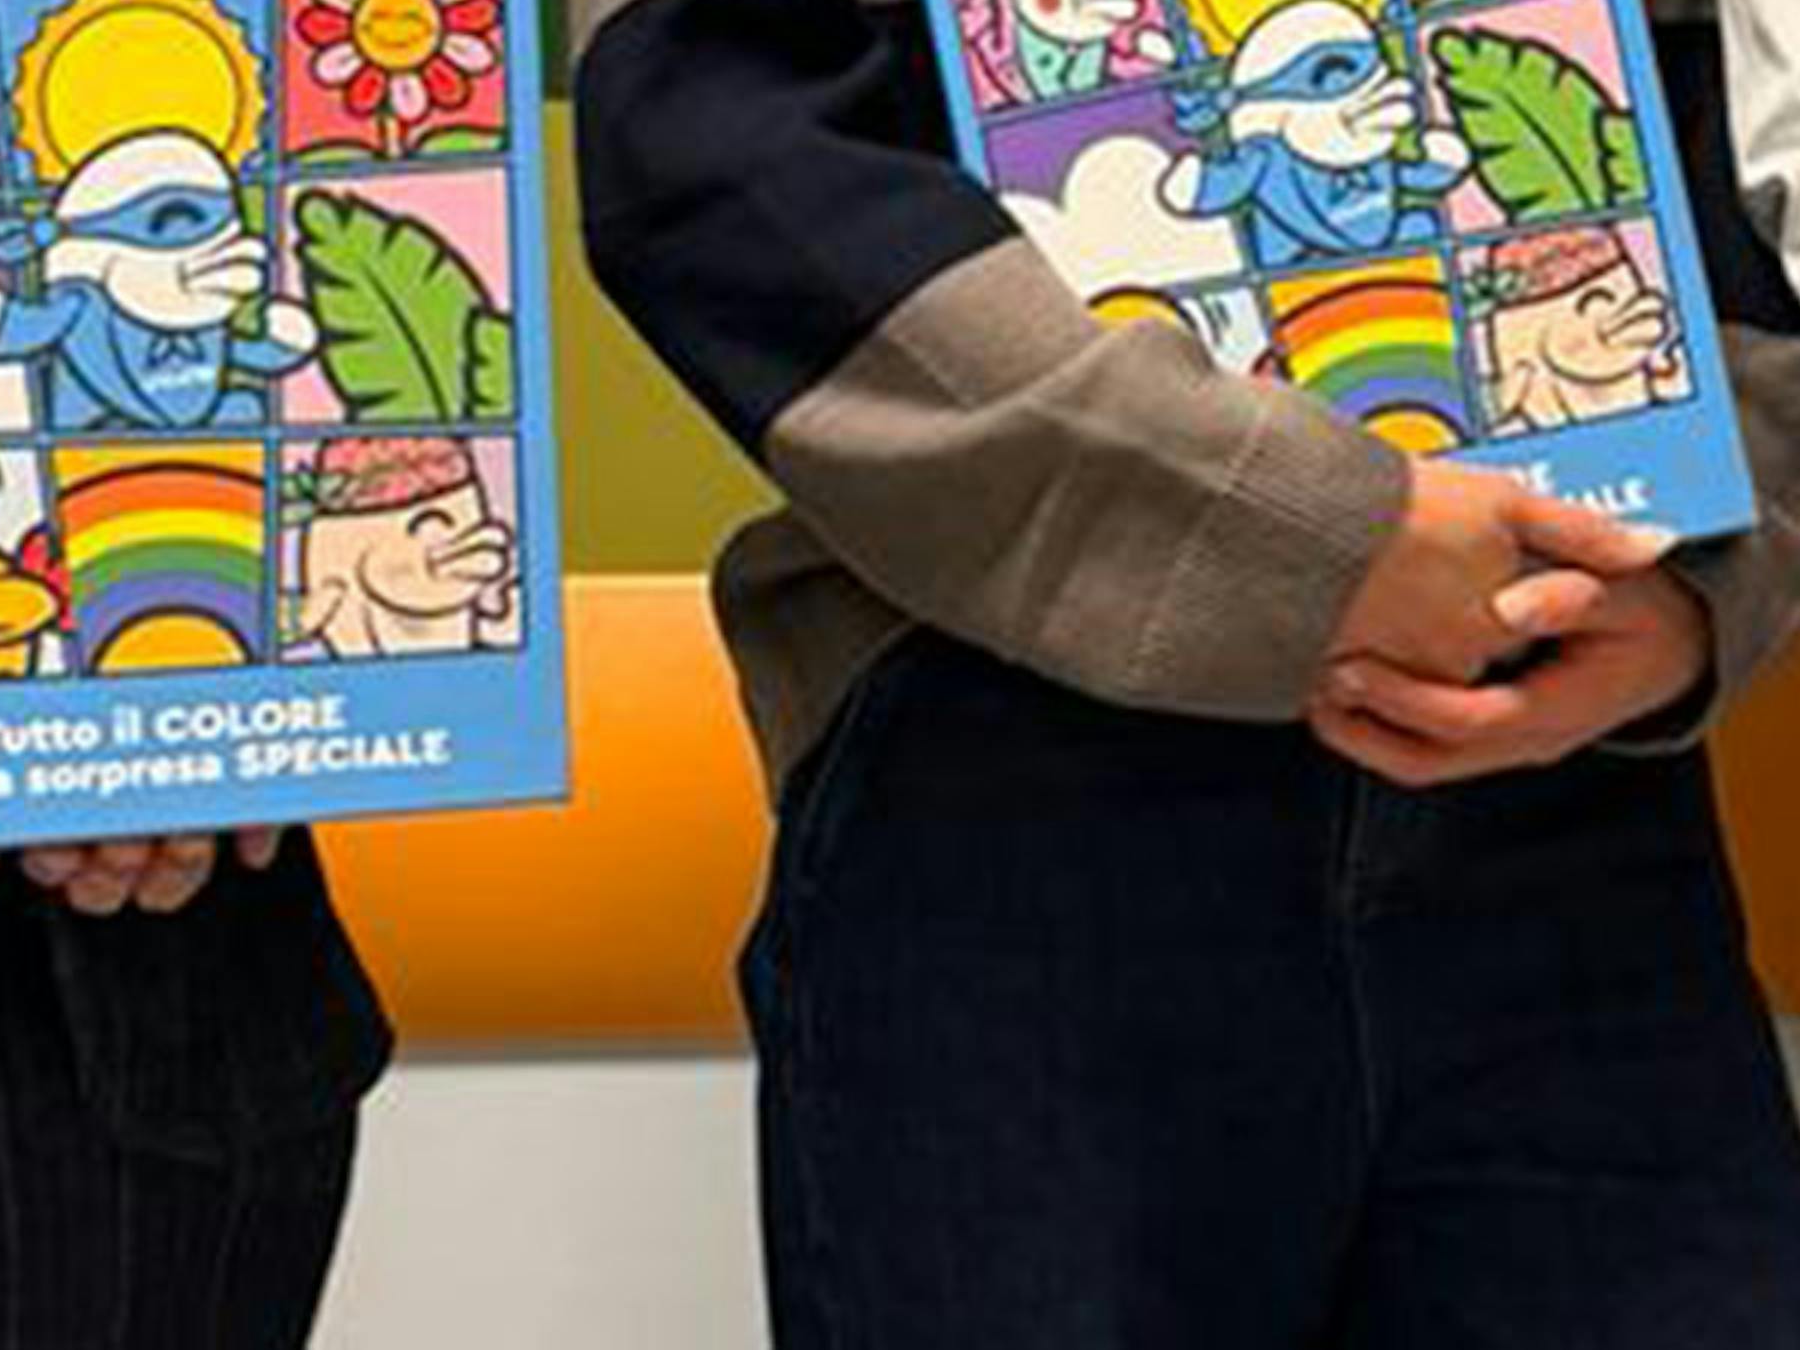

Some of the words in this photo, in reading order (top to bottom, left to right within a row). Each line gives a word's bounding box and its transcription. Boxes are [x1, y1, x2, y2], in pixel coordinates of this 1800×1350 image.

[113, 705, 142, 745] il
[154, 696, 348, 742] COLORE
[27, 752, 223, 796] sorpresa
[235, 729, 451, 779] SPECIALE
